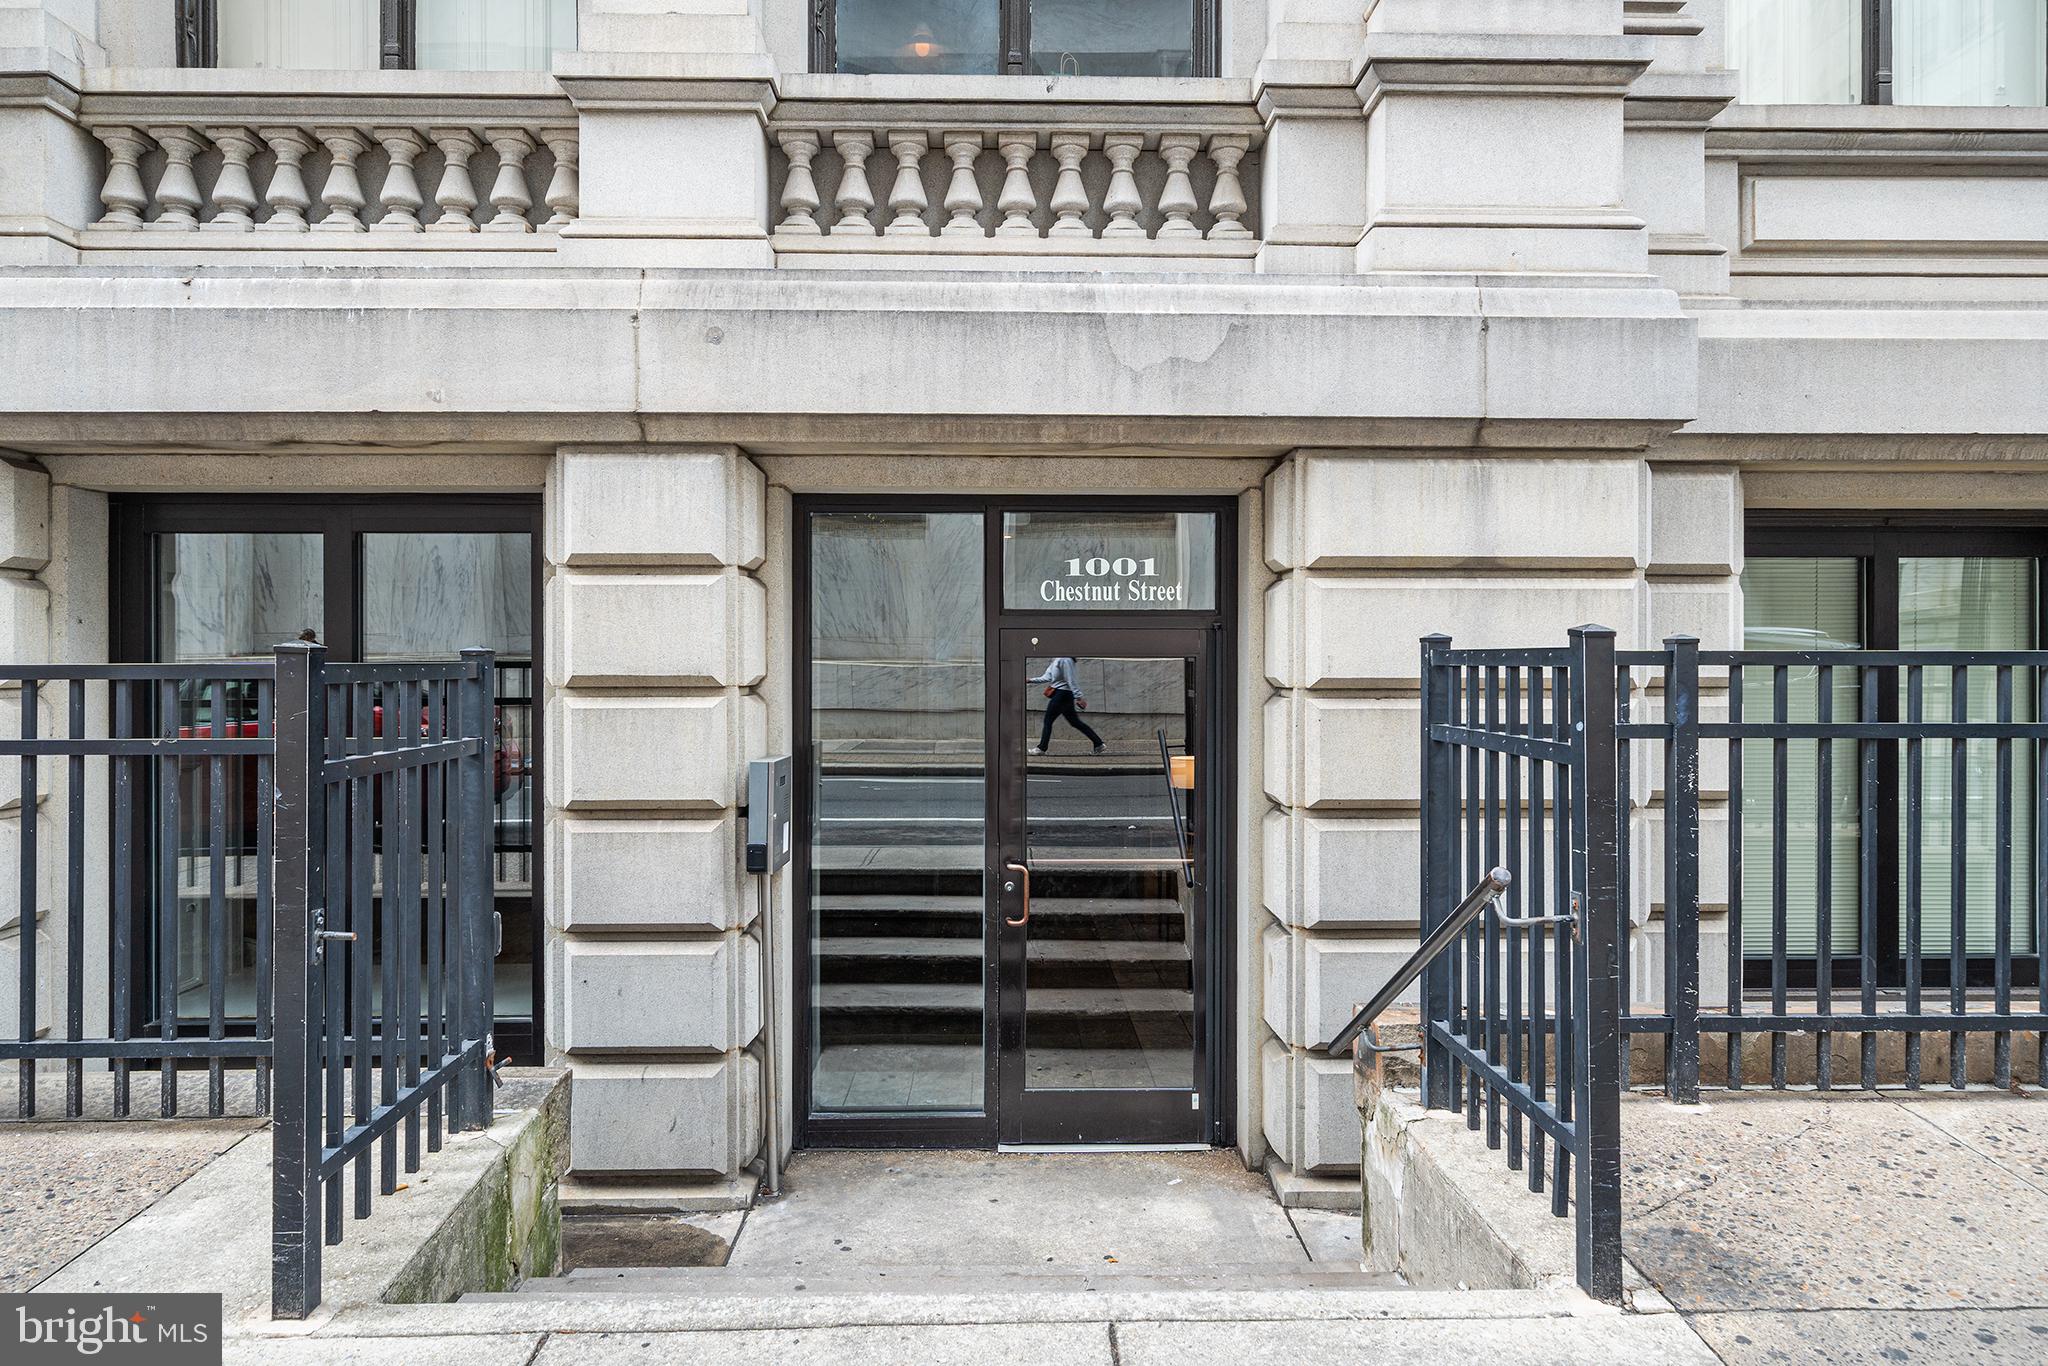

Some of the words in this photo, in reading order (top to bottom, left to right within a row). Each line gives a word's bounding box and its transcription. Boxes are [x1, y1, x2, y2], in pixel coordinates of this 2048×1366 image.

[1064, 557, 1160, 577] 1001
[1040, 579, 1121, 602] Chestnut
[1128, 579, 1183, 602] Street
